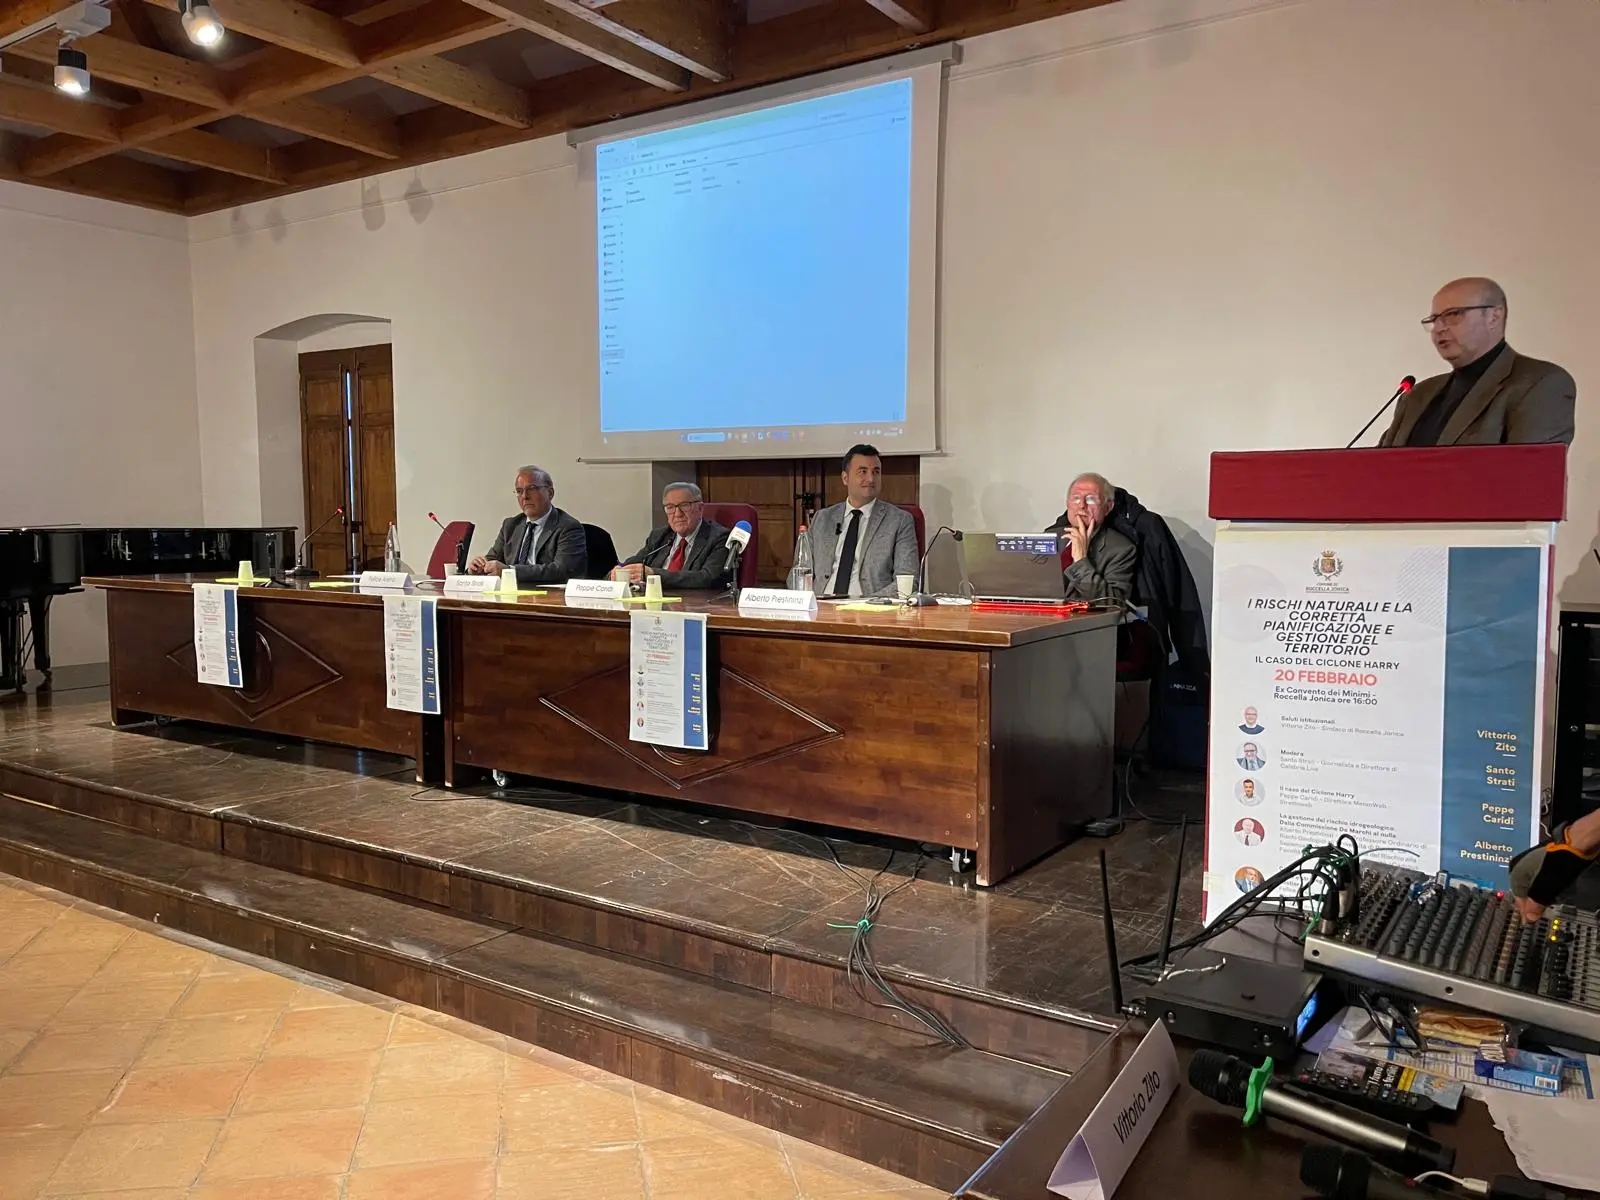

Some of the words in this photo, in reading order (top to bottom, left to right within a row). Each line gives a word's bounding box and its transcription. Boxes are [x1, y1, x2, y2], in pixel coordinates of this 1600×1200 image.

[745, 592, 770, 602] Alberto
[1248, 598, 1252, 609] I
[1255, 599, 1302, 610] RISCHI
[1305, 600, 1379, 612] NATURALI
[1382, 602, 1392, 612] E
[1394, 602, 1413, 613] LA
[1289, 611, 1366, 622] CORRETTA
[1263, 621, 1382, 634] PIANIFICAZIONE
[1385, 624, 1394, 634] E
[1276, 632, 1349, 644] GESTIONE
[1352, 634, 1379, 645] DEL
[1284, 642, 1370, 656] TERRITORIO
[1265, 656, 1293, 665] CASO
[1295, 658, 1313, 666] DEL
[1316, 659, 1361, 668] CICLONE
[1364, 661, 1400, 670] HARRY
[1274, 669, 1295, 681] 20
[1298, 670, 1377, 686] FEBBRAIO
[1286, 686, 1326, 696] Convento
[1342, 690, 1371, 698] Minimi
[1274, 692, 1307, 701] Roccella
[1310, 695, 1336, 703] Jonica
[1354, 697, 1378, 705] 16:00
[1477, 730, 1516, 740] Vittorio
[1495, 742, 1516, 752] Zito
[1486, 765, 1516, 775] Santo
[1486, 776, 1515, 787] Strati
[1336, 791, 1355, 799] Harry
[1482, 803, 1514, 815] Peppe
[1288, 814, 1314, 822] gestione
[1483, 814, 1514, 825] Caridi
[1296, 821, 1338, 832] Commissione
[1349, 827, 1372, 836] Marchi
[1474, 840, 1513, 852] Alberto
[1460, 850, 1512, 863] Prestininz
[1113, 1092, 1146, 1144] Vittorio
[1142, 1071, 1160, 1103] Zito
